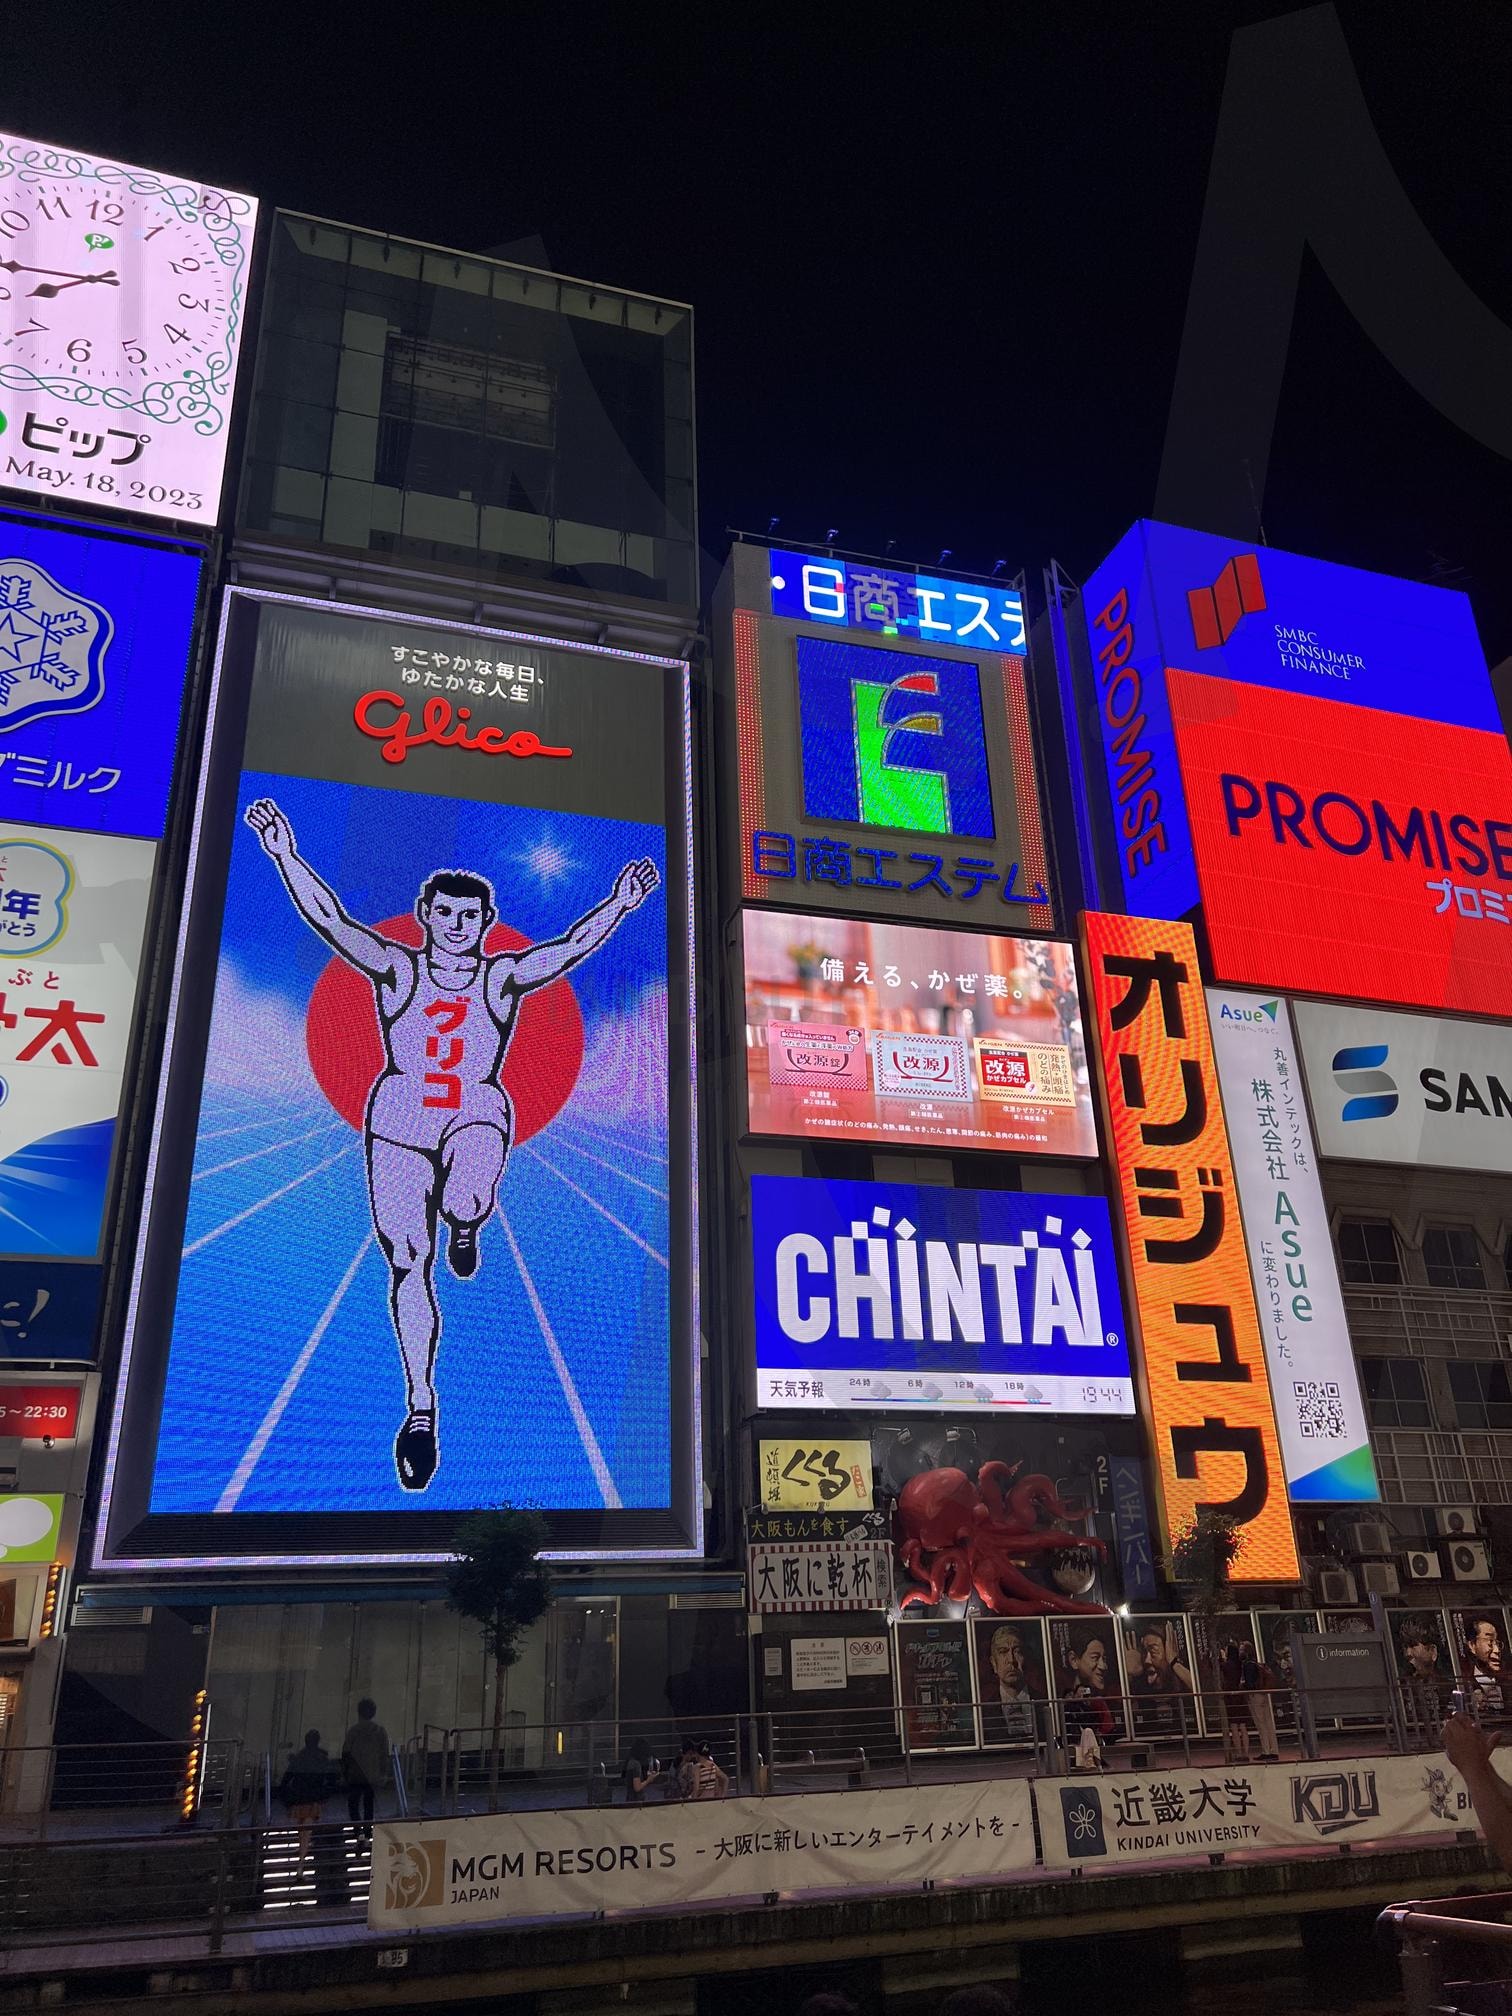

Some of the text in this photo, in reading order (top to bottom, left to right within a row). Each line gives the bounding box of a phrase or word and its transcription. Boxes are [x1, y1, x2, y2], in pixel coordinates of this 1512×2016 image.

[36, 197, 72, 221] 11
[86, 199, 125, 227] 12
[178, 293, 210, 313] 3
[66, 338, 93, 363] 6
[163, 323, 192, 345] 4
[121, 338, 147, 365] 5
[21, 411, 152, 466] ピップ
[6, 456, 204, 511] May. 18, 2023
[1274, 624, 1319, 645] SMBC
[391, 645, 545, 686] すこやかな毎日、
[1277, 639, 1367, 671] CONSUMER
[1281, 653, 1352, 681] FINANCE
[402, 667, 529, 703] ゆたかな人生
[353, 689, 574, 764] Glico
[1094, 587, 1168, 878] PROMISE
[1220, 772, 1512, 882] PROMISE
[752, 829, 1051, 905] 日商エステム
[0, 888, 42, 920] 年
[1425, 877, 1512, 925] プロミ
[820, 957, 1025, 1000] 備える、かぜ薬。
[1220, 1003, 1263, 1023] Asue
[422, 995, 472, 1110] グリコ
[902, 1055, 941, 1072] 改源
[985, 1060, 1026, 1078] 改源
[986, 1074, 1027, 1085] かぜカプセル
[1273, 1046, 1310, 1175] 丸善インテックは、
[1251, 1077, 1314, 1322] 株式会社 Asue
[775, 1205, 1105, 1347] CHINTAI
[1260, 1240, 1295, 1369] に変わりました。
[769, 1379, 825, 1399] 天気予報
[781, 1448, 851, 1501] くくる
[751, 1517, 849, 1539] 大阪もんを食す
[758, 1552, 873, 1600] 大阪に乾杯
[1328, 1648, 1370, 1657] information
[1111, 1778, 1257, 1828] 近畿大学
[1117, 1825, 1261, 1851] KINDAI UNIVERSITY
[451, 1842, 677, 1884] MGM RESORTS
[450, 1886, 500, 1904] JAPAN
